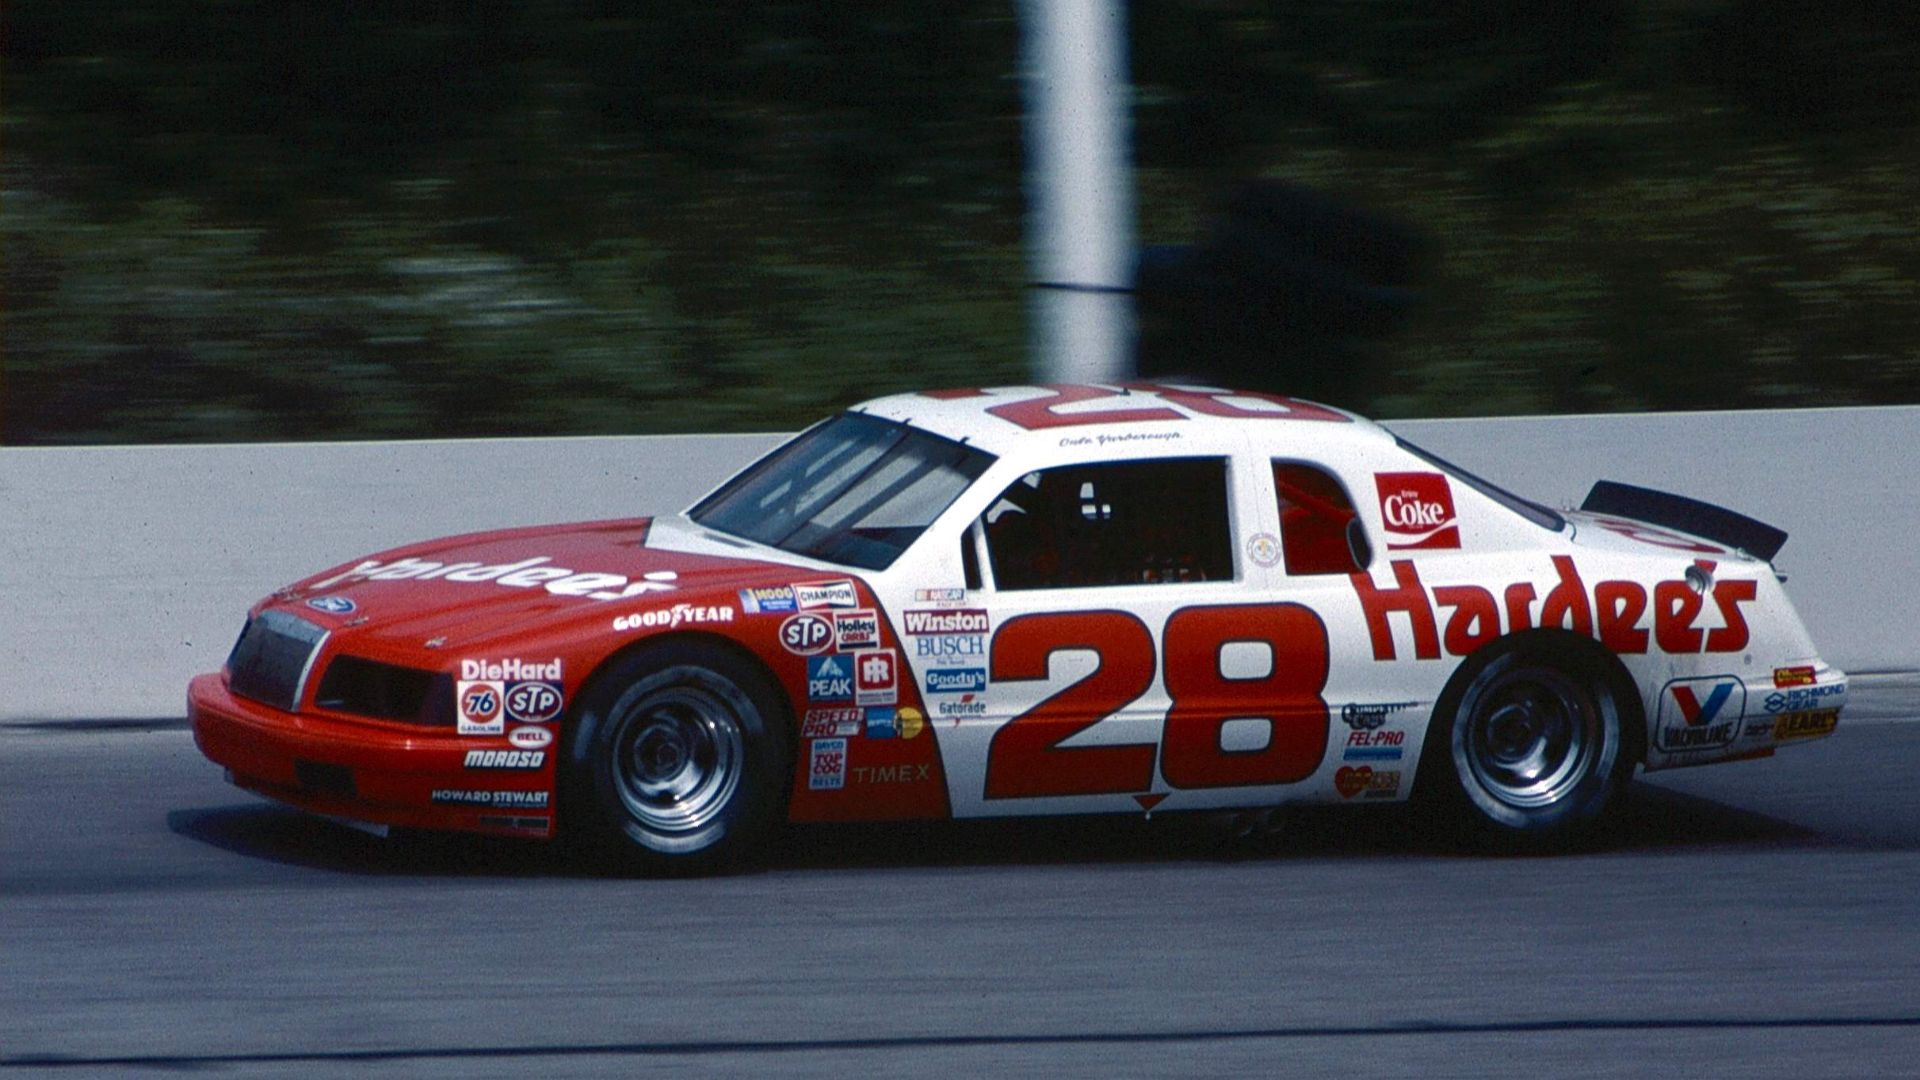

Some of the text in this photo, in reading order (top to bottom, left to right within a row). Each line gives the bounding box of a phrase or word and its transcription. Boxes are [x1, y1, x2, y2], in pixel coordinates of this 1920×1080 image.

[1384, 494, 1445, 527] Coke
[755, 587, 794, 600] MOOG
[800, 589, 853, 604] CHAMPION
[836, 619, 876, 635] Holley
[905, 611, 988, 633] Winston
[787, 617, 826, 646] STP
[916, 636, 984, 656] BUSCH
[461, 657, 561, 681] DieHard
[809, 678, 851, 697] PEAK
[927, 671, 985, 689] Goody's
[1787, 684, 1845, 699] RICHMOND
[466, 692, 495, 715] 76
[513, 686, 555, 714] STP
[939, 702, 987, 714] Gatorade
[983, 601, 1331, 800] 28
[1785, 699, 1819, 712] GEAR
[808, 709, 859, 723] SPEED
[516, 733, 545, 741] BELL
[803, 723, 838, 736] PRO
[814, 740, 844, 750] DAYCO
[1346, 731, 1405, 746] FEL-PRO
[464, 751, 545, 767] MOROSO
[816, 753, 843, 765] TOP
[853, 763, 930, 784] TIMEX
[431, 789, 549, 803] HOWARD STEWART
